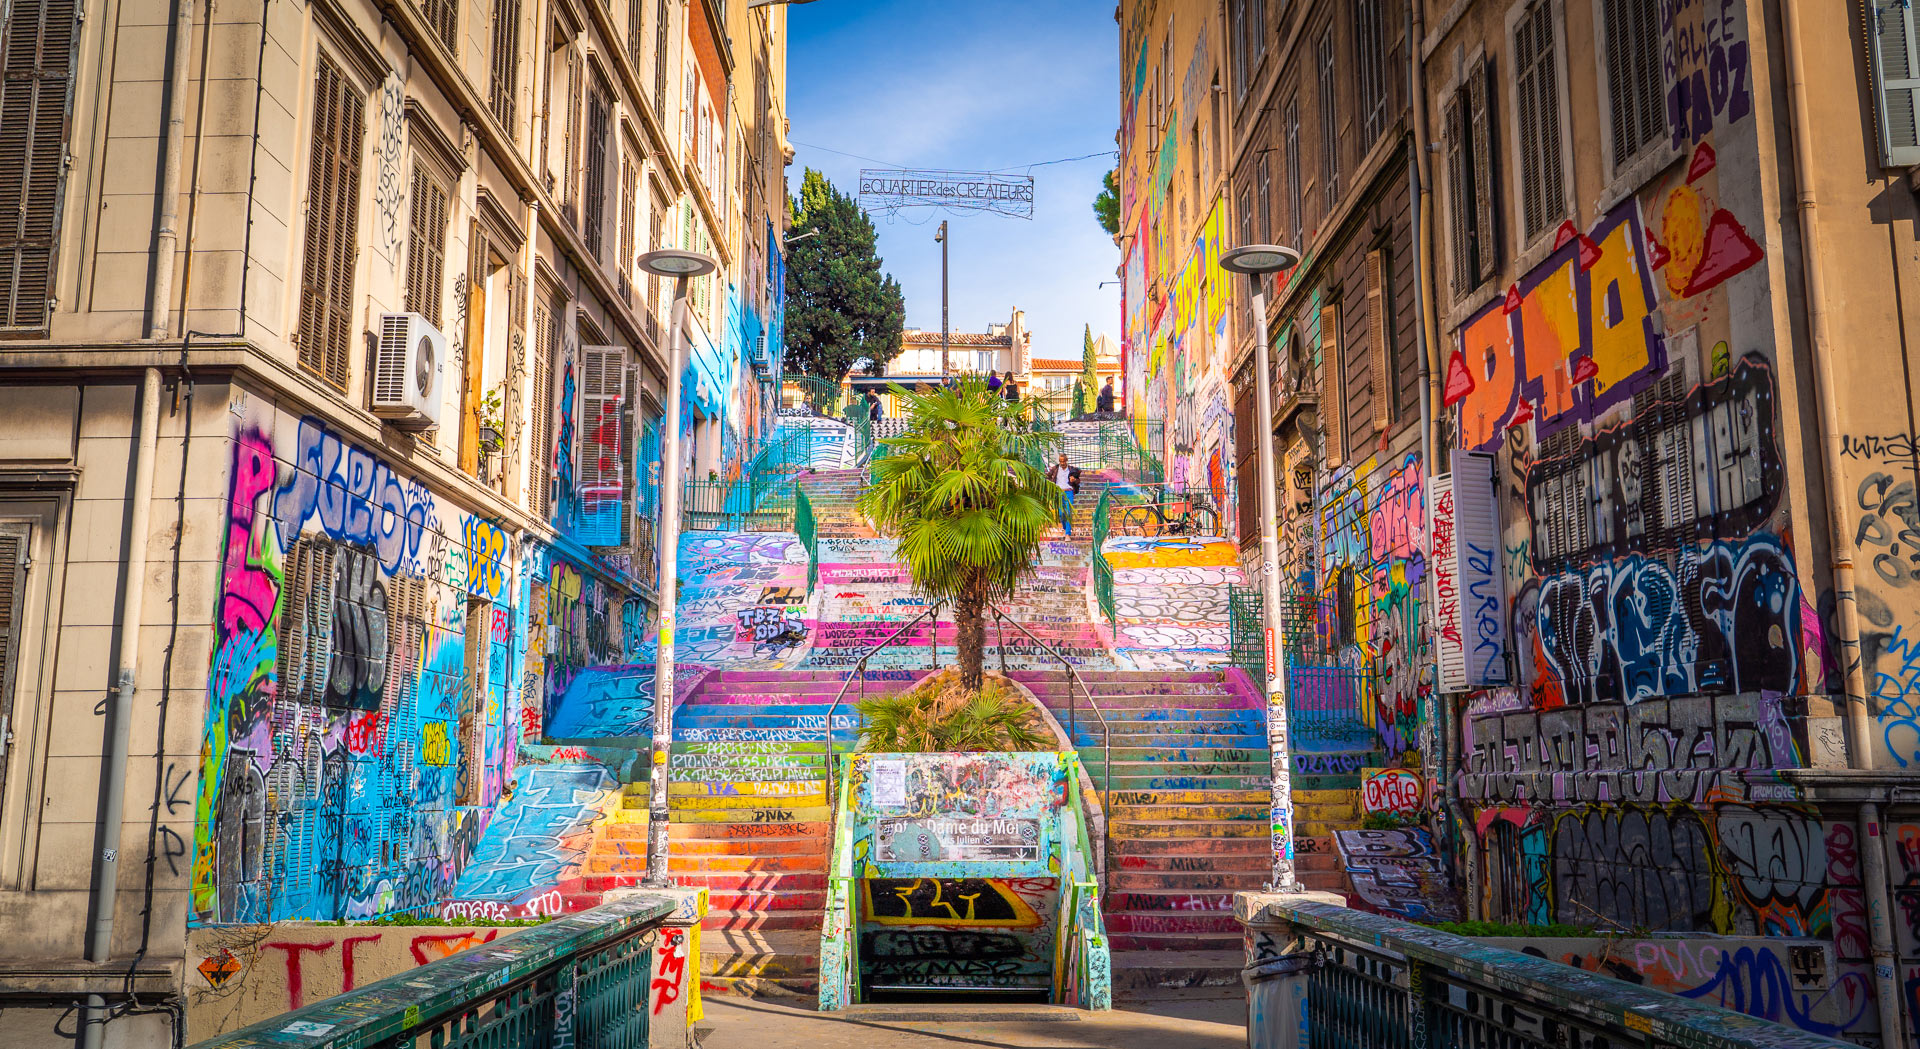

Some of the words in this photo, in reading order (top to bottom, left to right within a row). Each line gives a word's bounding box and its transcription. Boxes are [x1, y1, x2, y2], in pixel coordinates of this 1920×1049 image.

[871, 179, 937, 196] QUARTIER
[937, 182, 956, 197] des
[464, 514, 505, 599] LPC
[738, 607, 780, 629] TBZ
[927, 819, 967, 834] Dame
[969, 819, 988, 834] du
[526, 891, 562, 916] PTO
